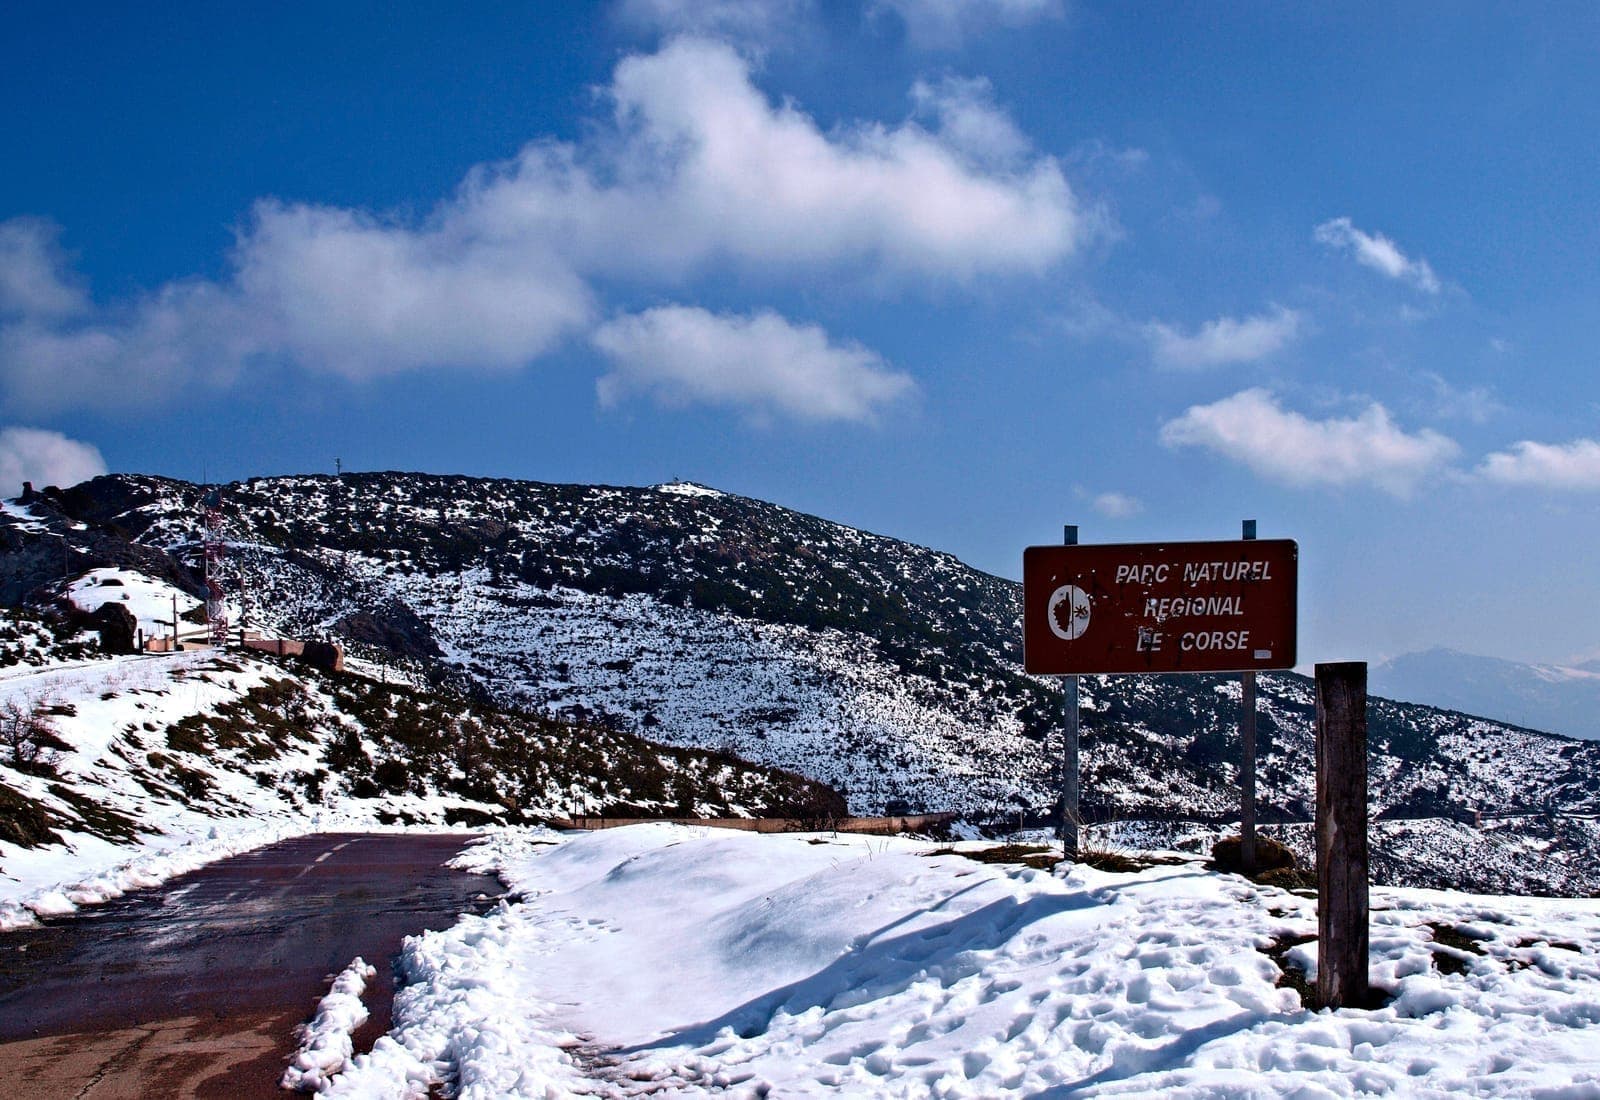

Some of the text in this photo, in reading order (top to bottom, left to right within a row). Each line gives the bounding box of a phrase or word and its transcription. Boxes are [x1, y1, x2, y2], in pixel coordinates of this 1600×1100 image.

[1115, 561, 1272, 584] PARC NATUREL
[1144, 596, 1244, 617] REGIONAL
[1181, 631, 1250, 651] CORSE
